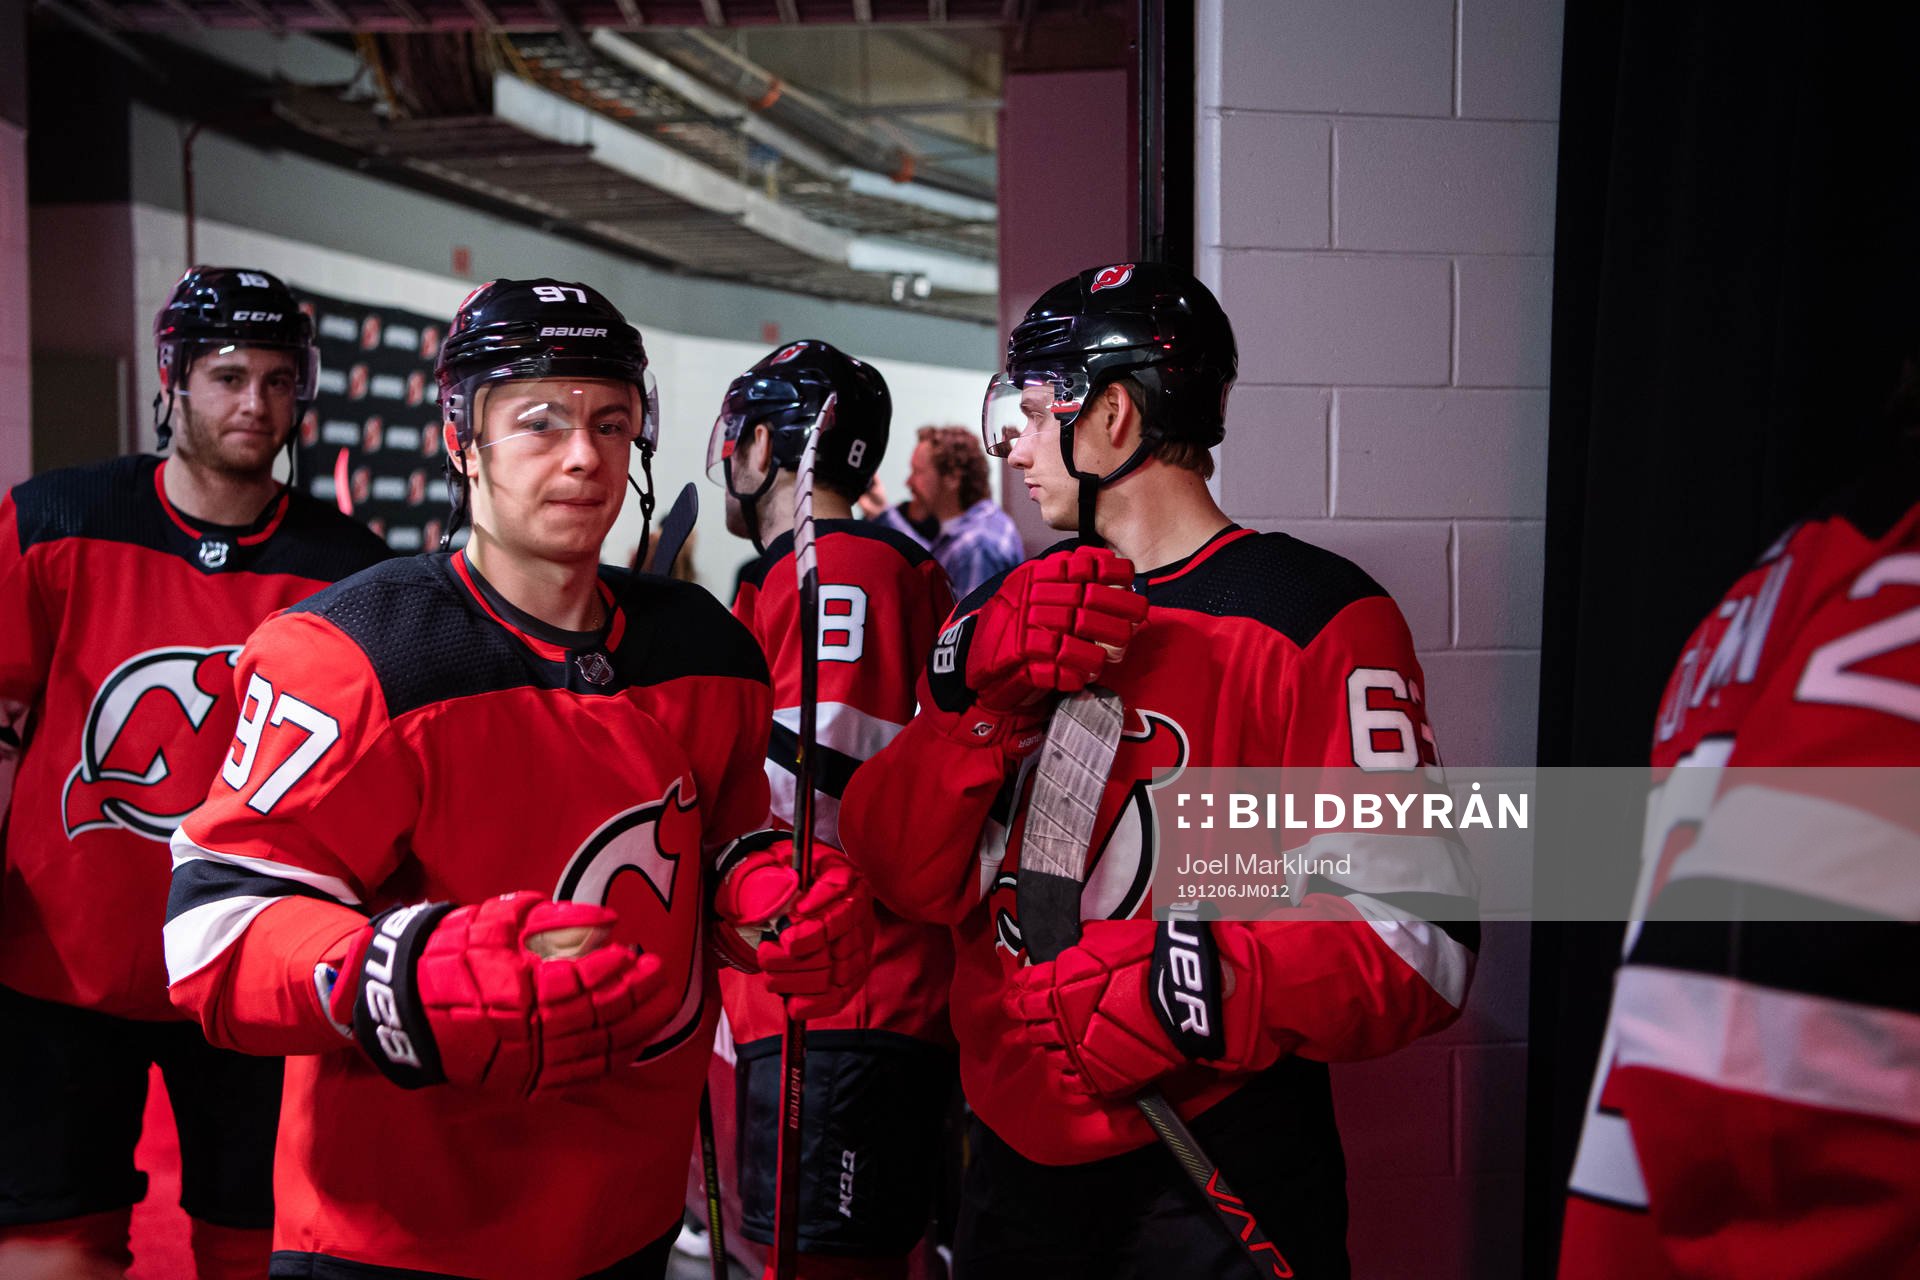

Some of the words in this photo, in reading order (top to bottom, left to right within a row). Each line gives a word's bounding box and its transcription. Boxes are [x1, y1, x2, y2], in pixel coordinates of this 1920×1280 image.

[232, 310, 283, 322] CCM
[532, 286, 588, 304] 97
[540, 326, 608, 338] BAUER
[848, 438, 867, 469] 8
[816, 583, 868, 663] 8
[222, 672, 341, 816] 97
[365, 899, 432, 1068] BAUE
[788, 1067, 801, 1129] BAUER
[838, 1150, 857, 1218] CCM
